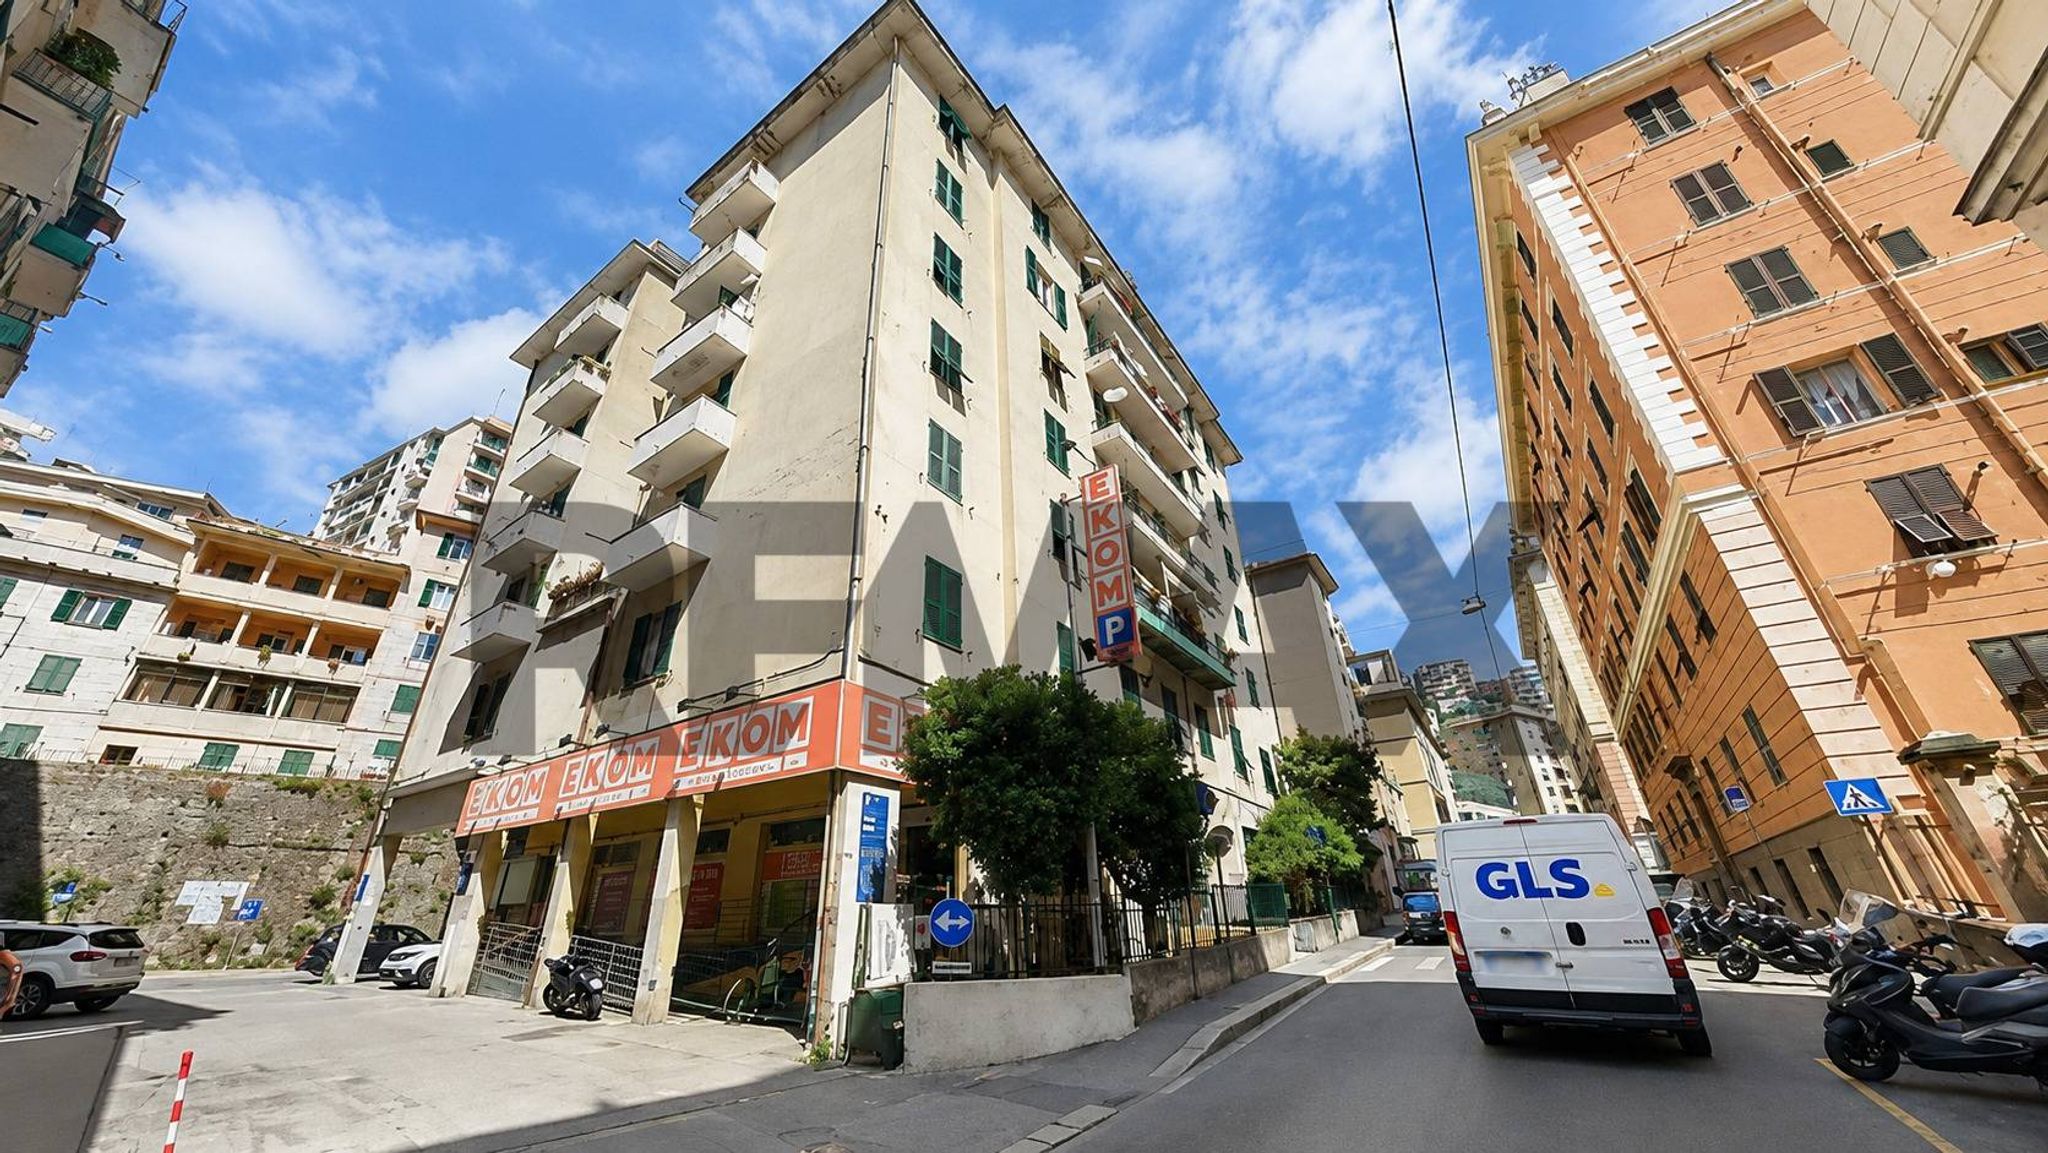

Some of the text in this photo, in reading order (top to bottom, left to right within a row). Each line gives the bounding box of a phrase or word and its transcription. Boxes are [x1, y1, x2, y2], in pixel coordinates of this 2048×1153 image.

[1089, 471, 1125, 608] EKOM
[1105, 615, 1125, 646] P
[680, 702, 810, 768] EKOM
[469, 770, 547, 814] EKOM
[561, 742, 657, 795] EKOM
[1475, 858, 1591, 900] GLS
